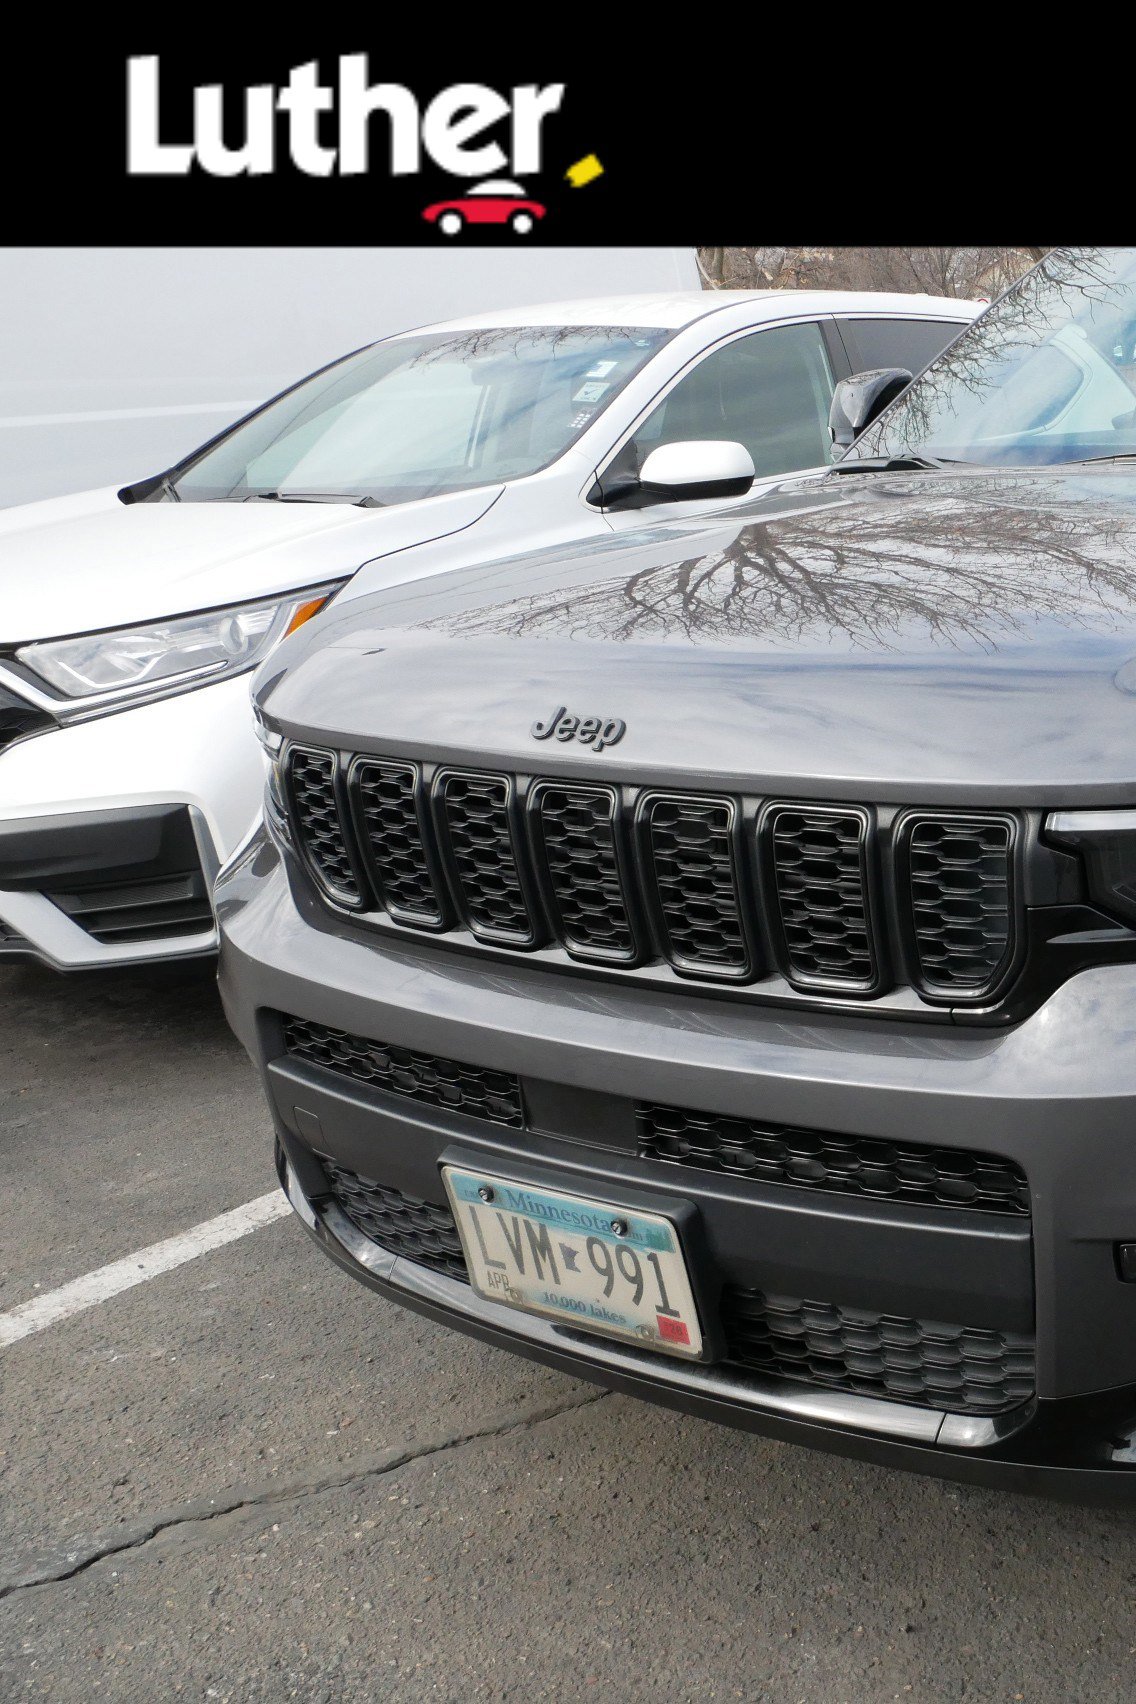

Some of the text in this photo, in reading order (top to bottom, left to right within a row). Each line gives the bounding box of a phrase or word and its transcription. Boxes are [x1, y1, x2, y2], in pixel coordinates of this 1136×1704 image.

[531, 706, 627, 752] Jeep
[505, 1189, 610, 1231] Minnesota
[469, 1206, 681, 1318] LVM 991
[589, 1304, 627, 1324] lakes
